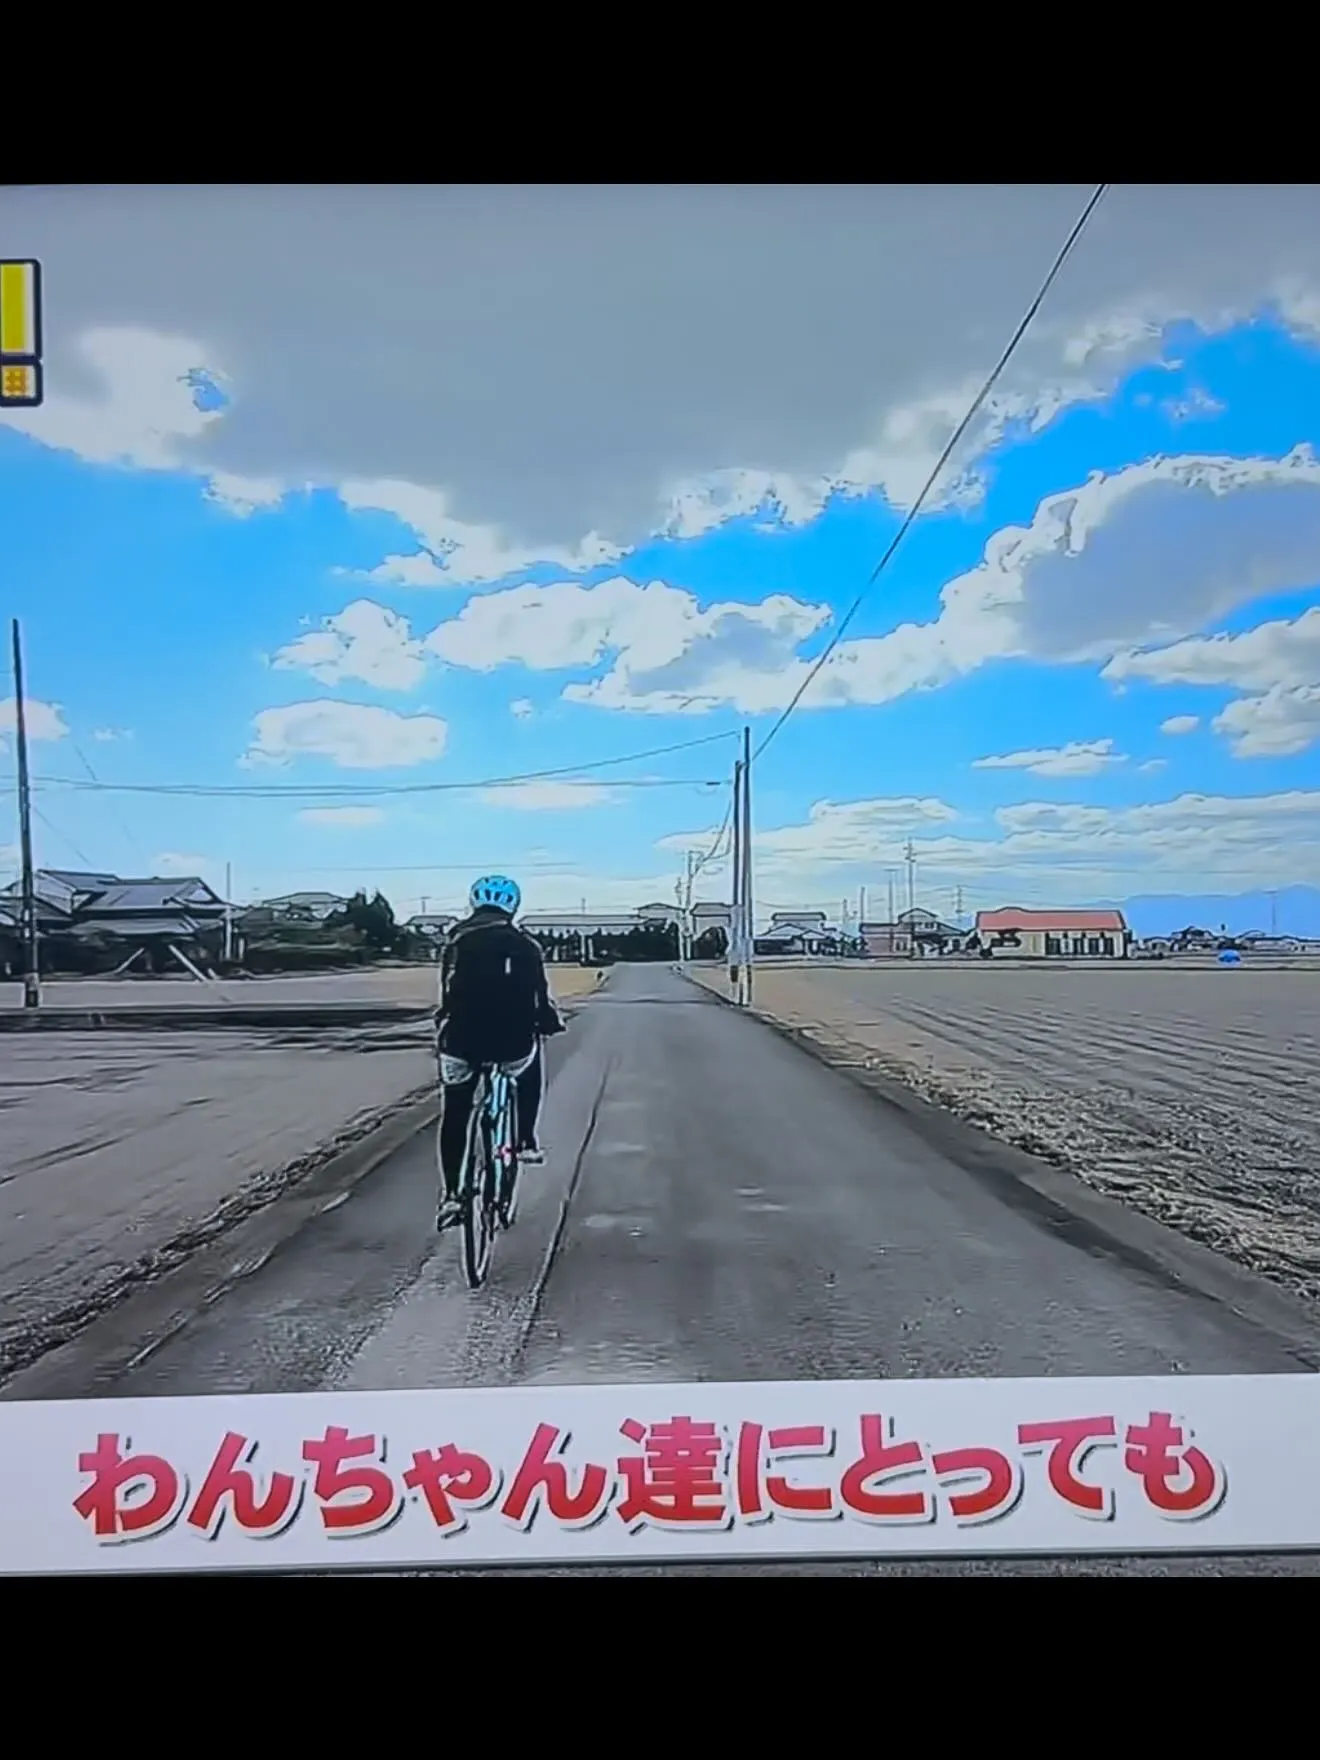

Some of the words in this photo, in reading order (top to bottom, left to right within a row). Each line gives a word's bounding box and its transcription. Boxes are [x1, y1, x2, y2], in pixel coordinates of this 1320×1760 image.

[73, 1411, 1227, 1543] わんちゃん達にとっても
